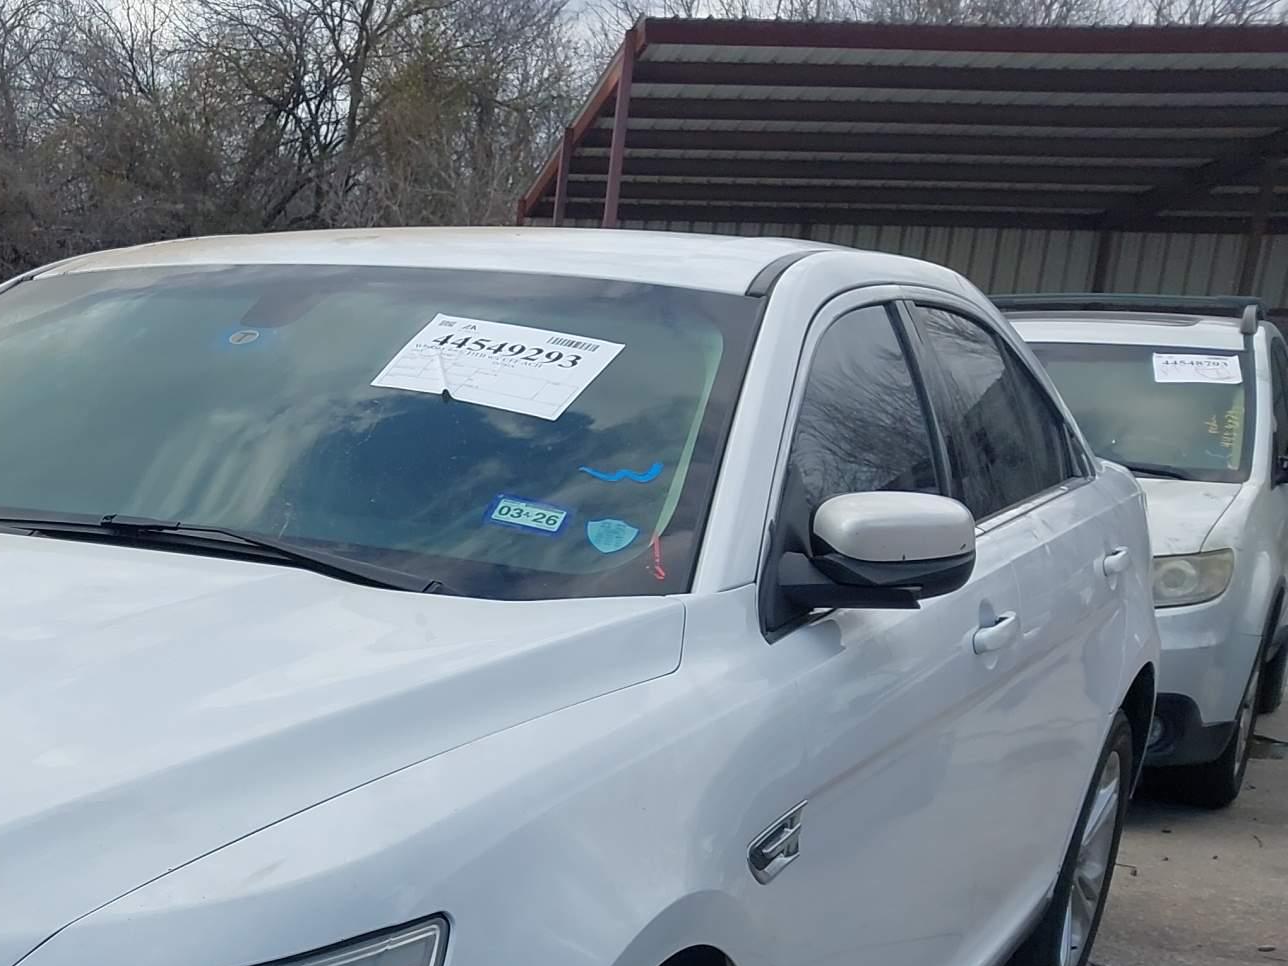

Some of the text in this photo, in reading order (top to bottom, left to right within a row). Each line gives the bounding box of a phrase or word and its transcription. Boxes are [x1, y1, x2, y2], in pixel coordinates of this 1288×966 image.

[432, 333, 583, 369] 44549293
[498, 505, 524, 519] 03
[532, 512, 560, 526] 26
